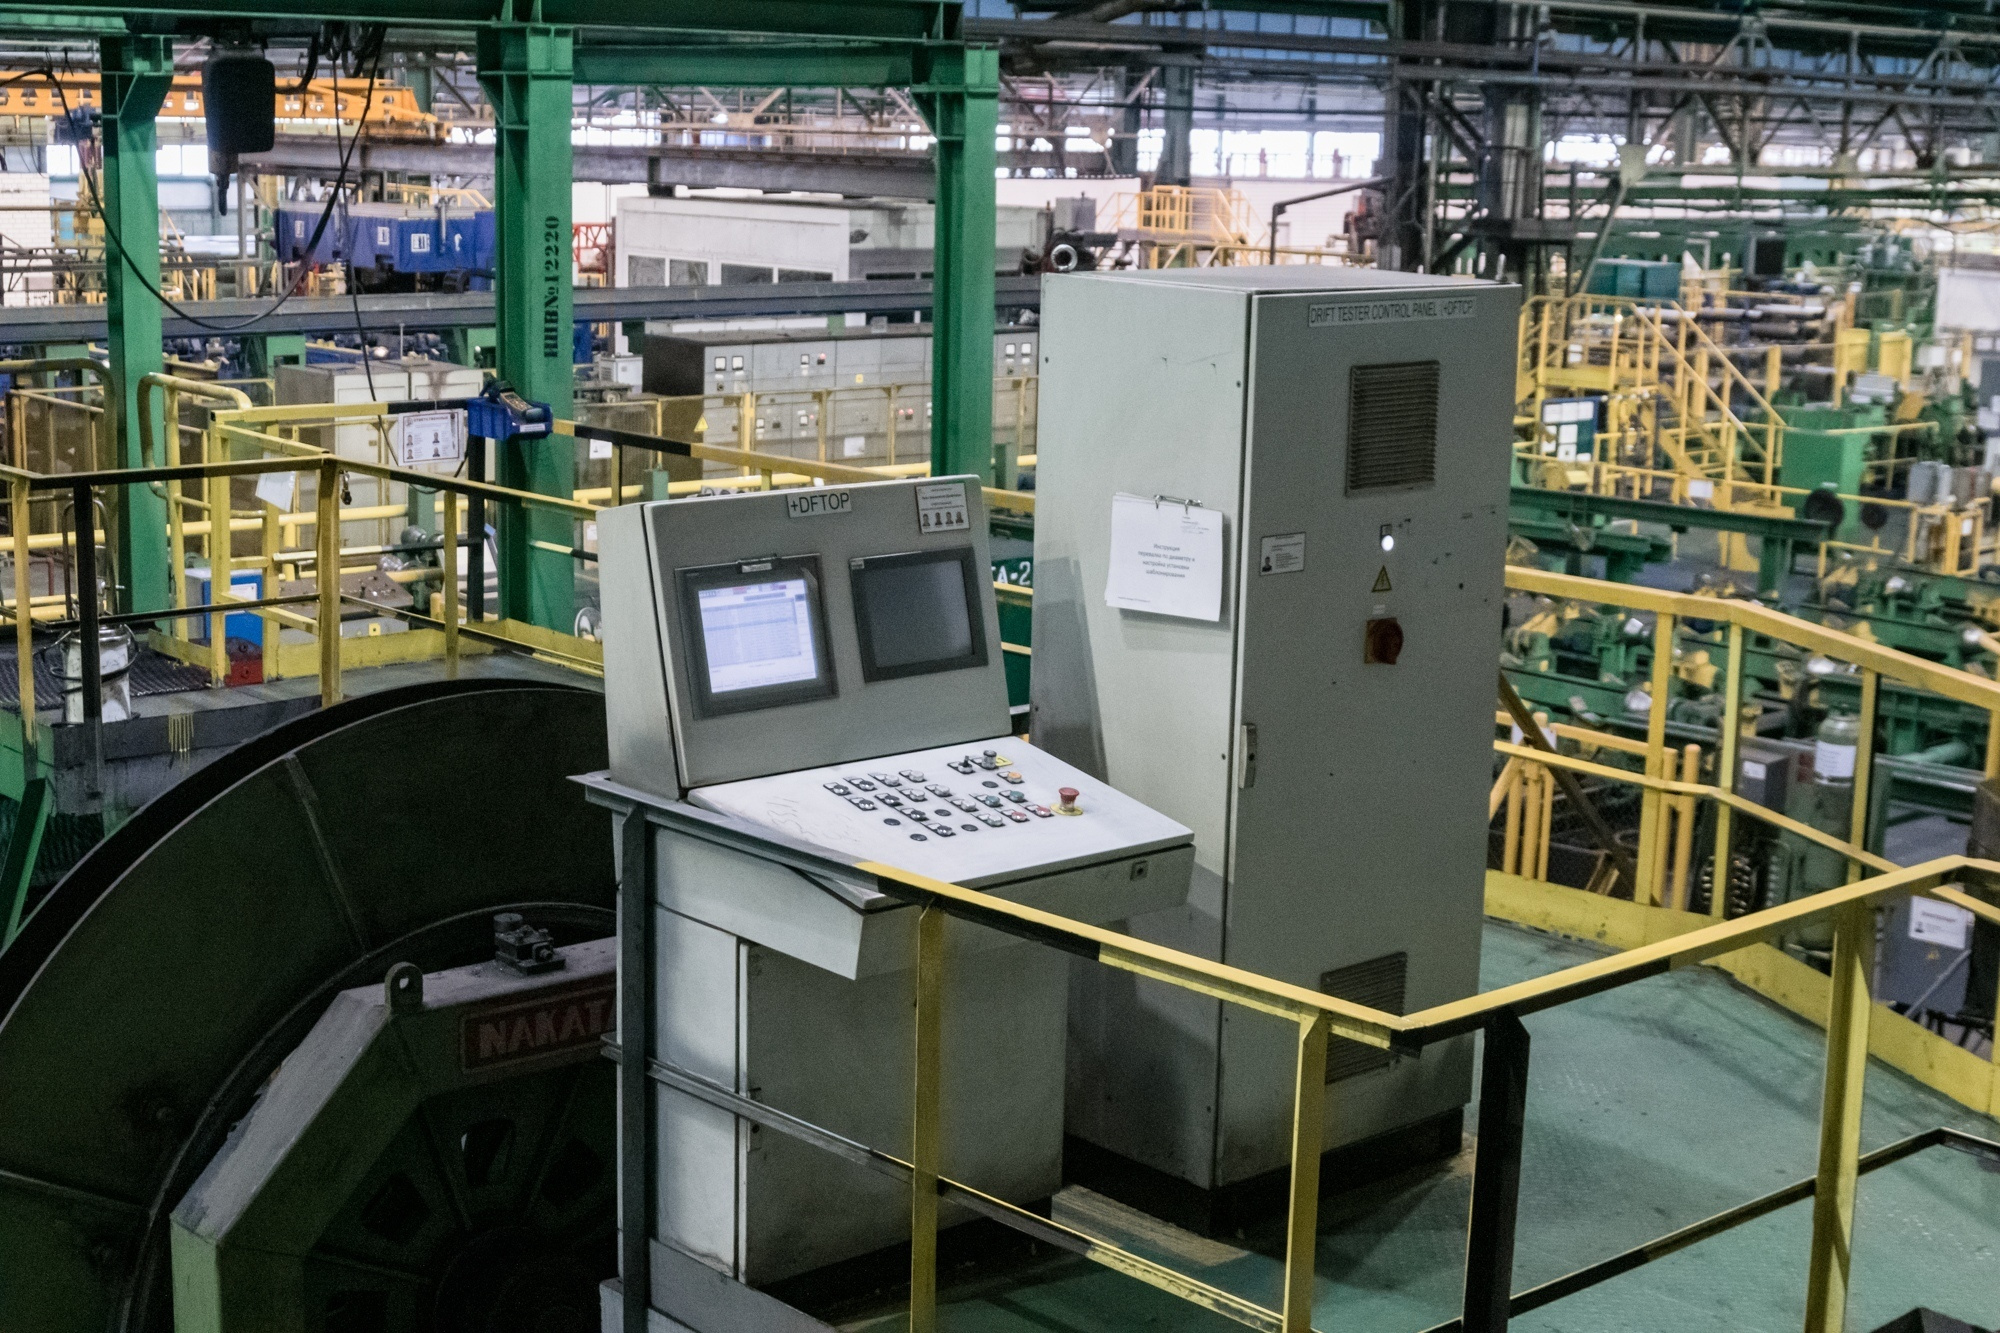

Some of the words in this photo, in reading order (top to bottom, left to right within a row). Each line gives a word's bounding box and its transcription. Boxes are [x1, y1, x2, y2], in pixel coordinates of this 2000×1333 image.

[1310, 307, 1335, 324] DRIFT
[1338, 305, 1370, 321] TESTER
[1372, 303, 1411, 319] CONTROL
[1413, 302, 1437, 317] PANEL
[790, 492, 850, 513] +DFTOP
